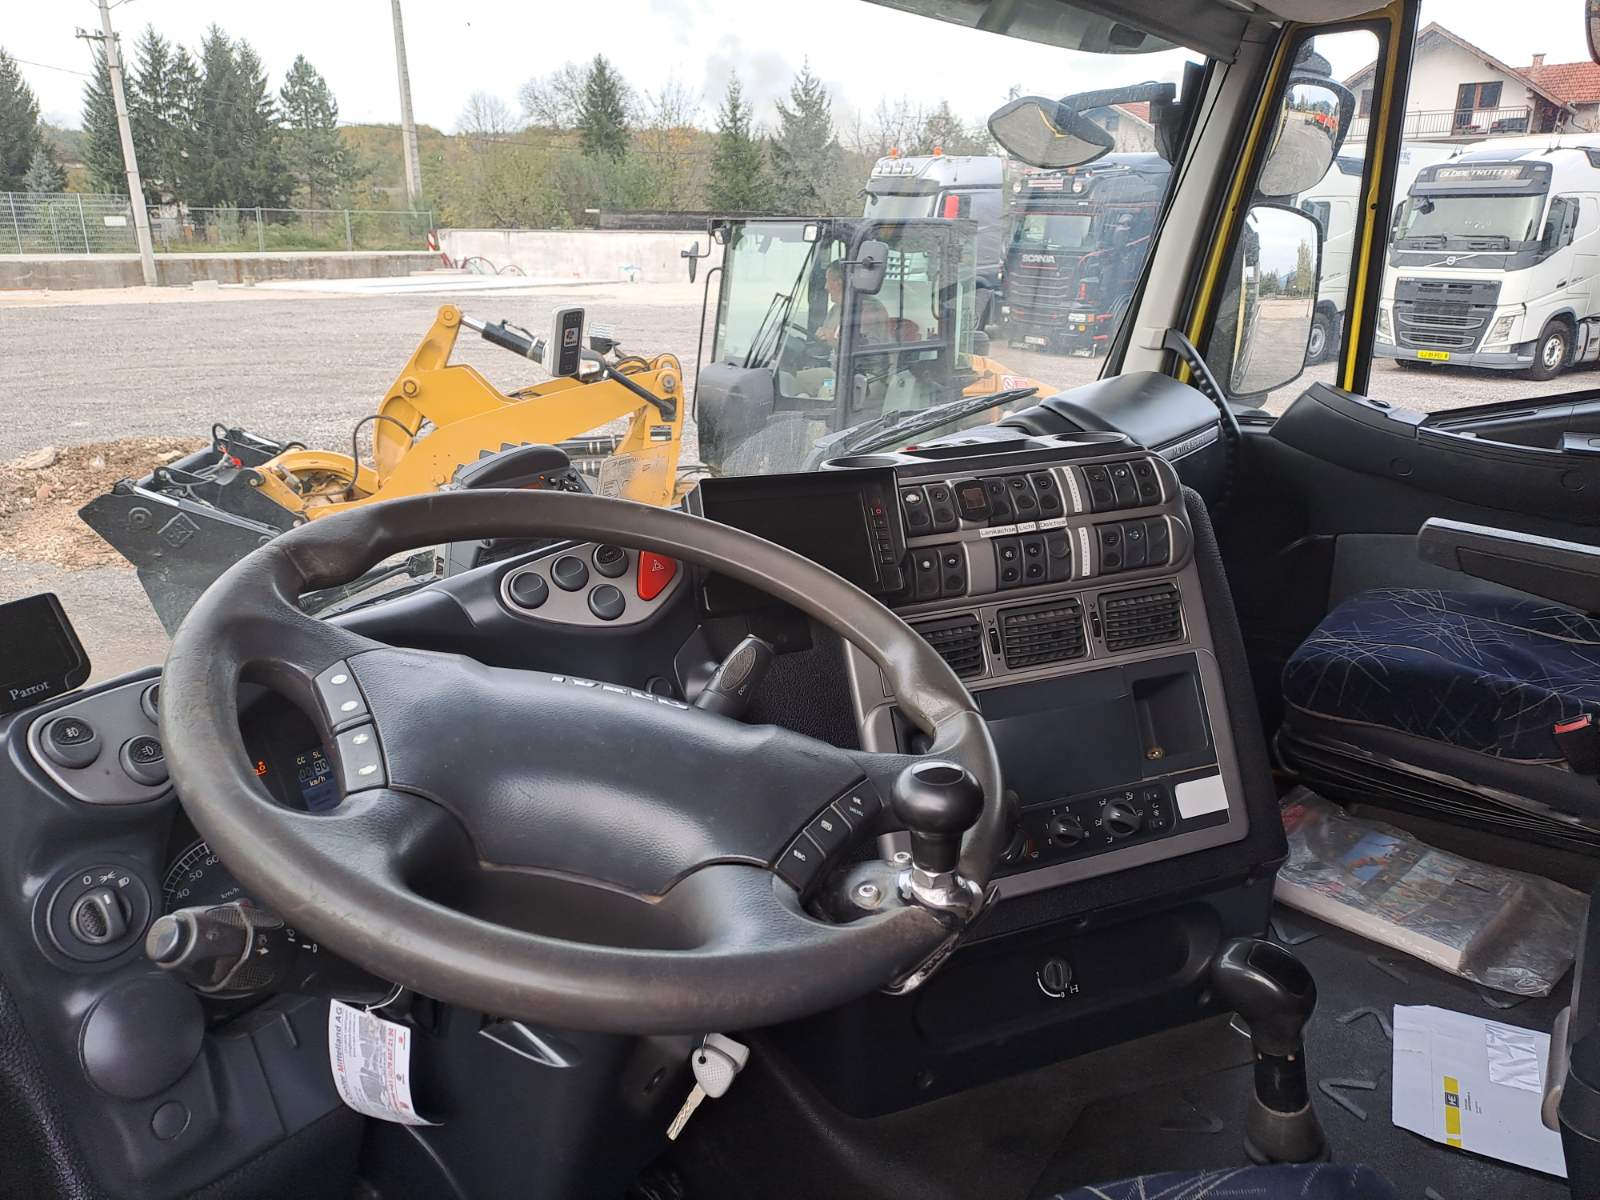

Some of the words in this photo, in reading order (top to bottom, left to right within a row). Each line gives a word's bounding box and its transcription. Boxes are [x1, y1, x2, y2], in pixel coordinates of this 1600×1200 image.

[1022, 254, 1057, 264] SCANIA
[9, 682, 48, 700] Parrot
[296, 756, 306, 765] CC
[206, 854, 220, 866] 60
[189, 870, 203, 881] 50
[176, 888, 190, 900] 40
[336, 1007, 344, 1023] AG
[335, 1025, 345, 1072] Mittelland
